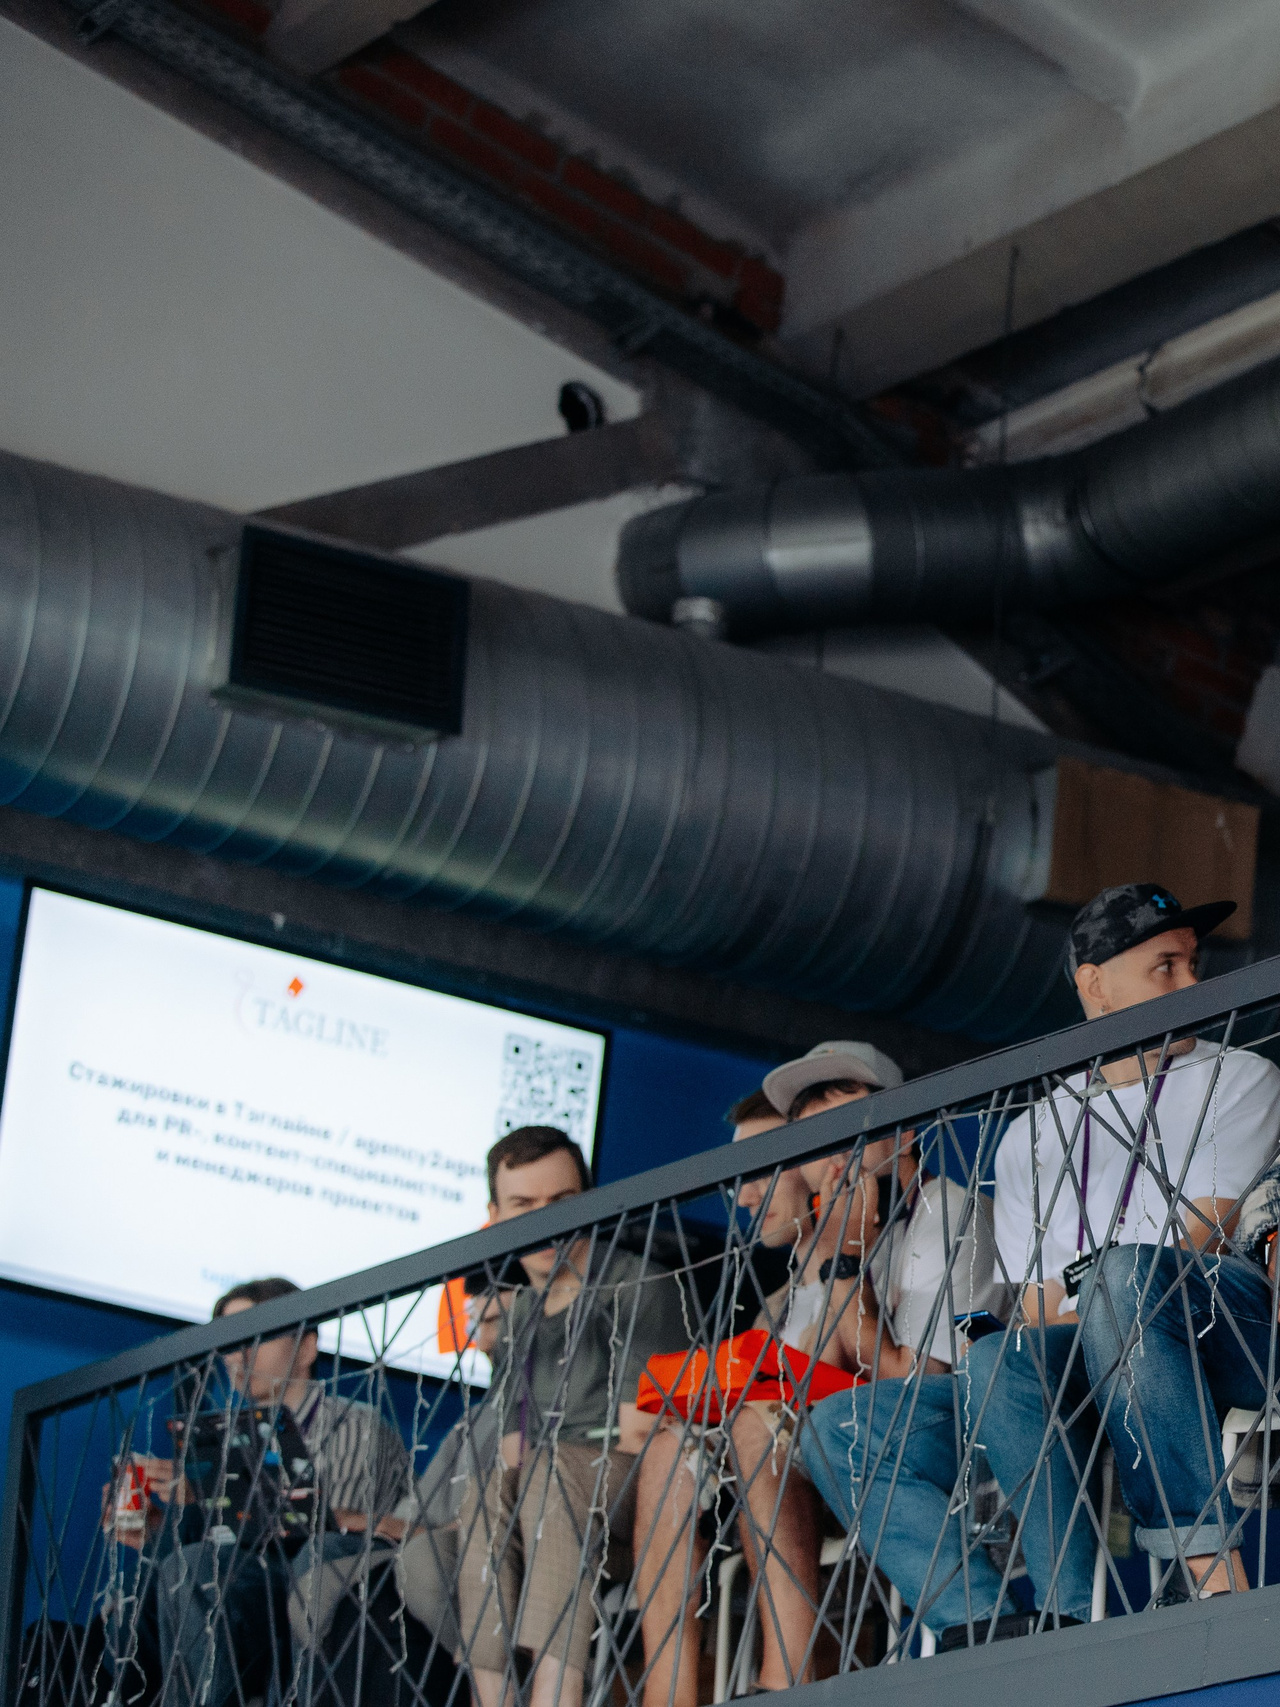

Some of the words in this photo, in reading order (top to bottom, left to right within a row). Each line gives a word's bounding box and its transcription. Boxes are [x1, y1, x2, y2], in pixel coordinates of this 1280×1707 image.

[252, 996, 389, 1059] TAGLINE
[68, 1059, 210, 1110] Стажировки
[215, 1102, 226, 1114] в
[234, 1100, 332, 1140] Тэглайне
[117, 1107, 157, 1128] для
[213, 1132, 464, 1203] контент-специалистов
[156, 1149, 169, 1162] и
[175, 1154, 314, 1197] менеджеров
[320, 1186, 420, 1222] проектов
